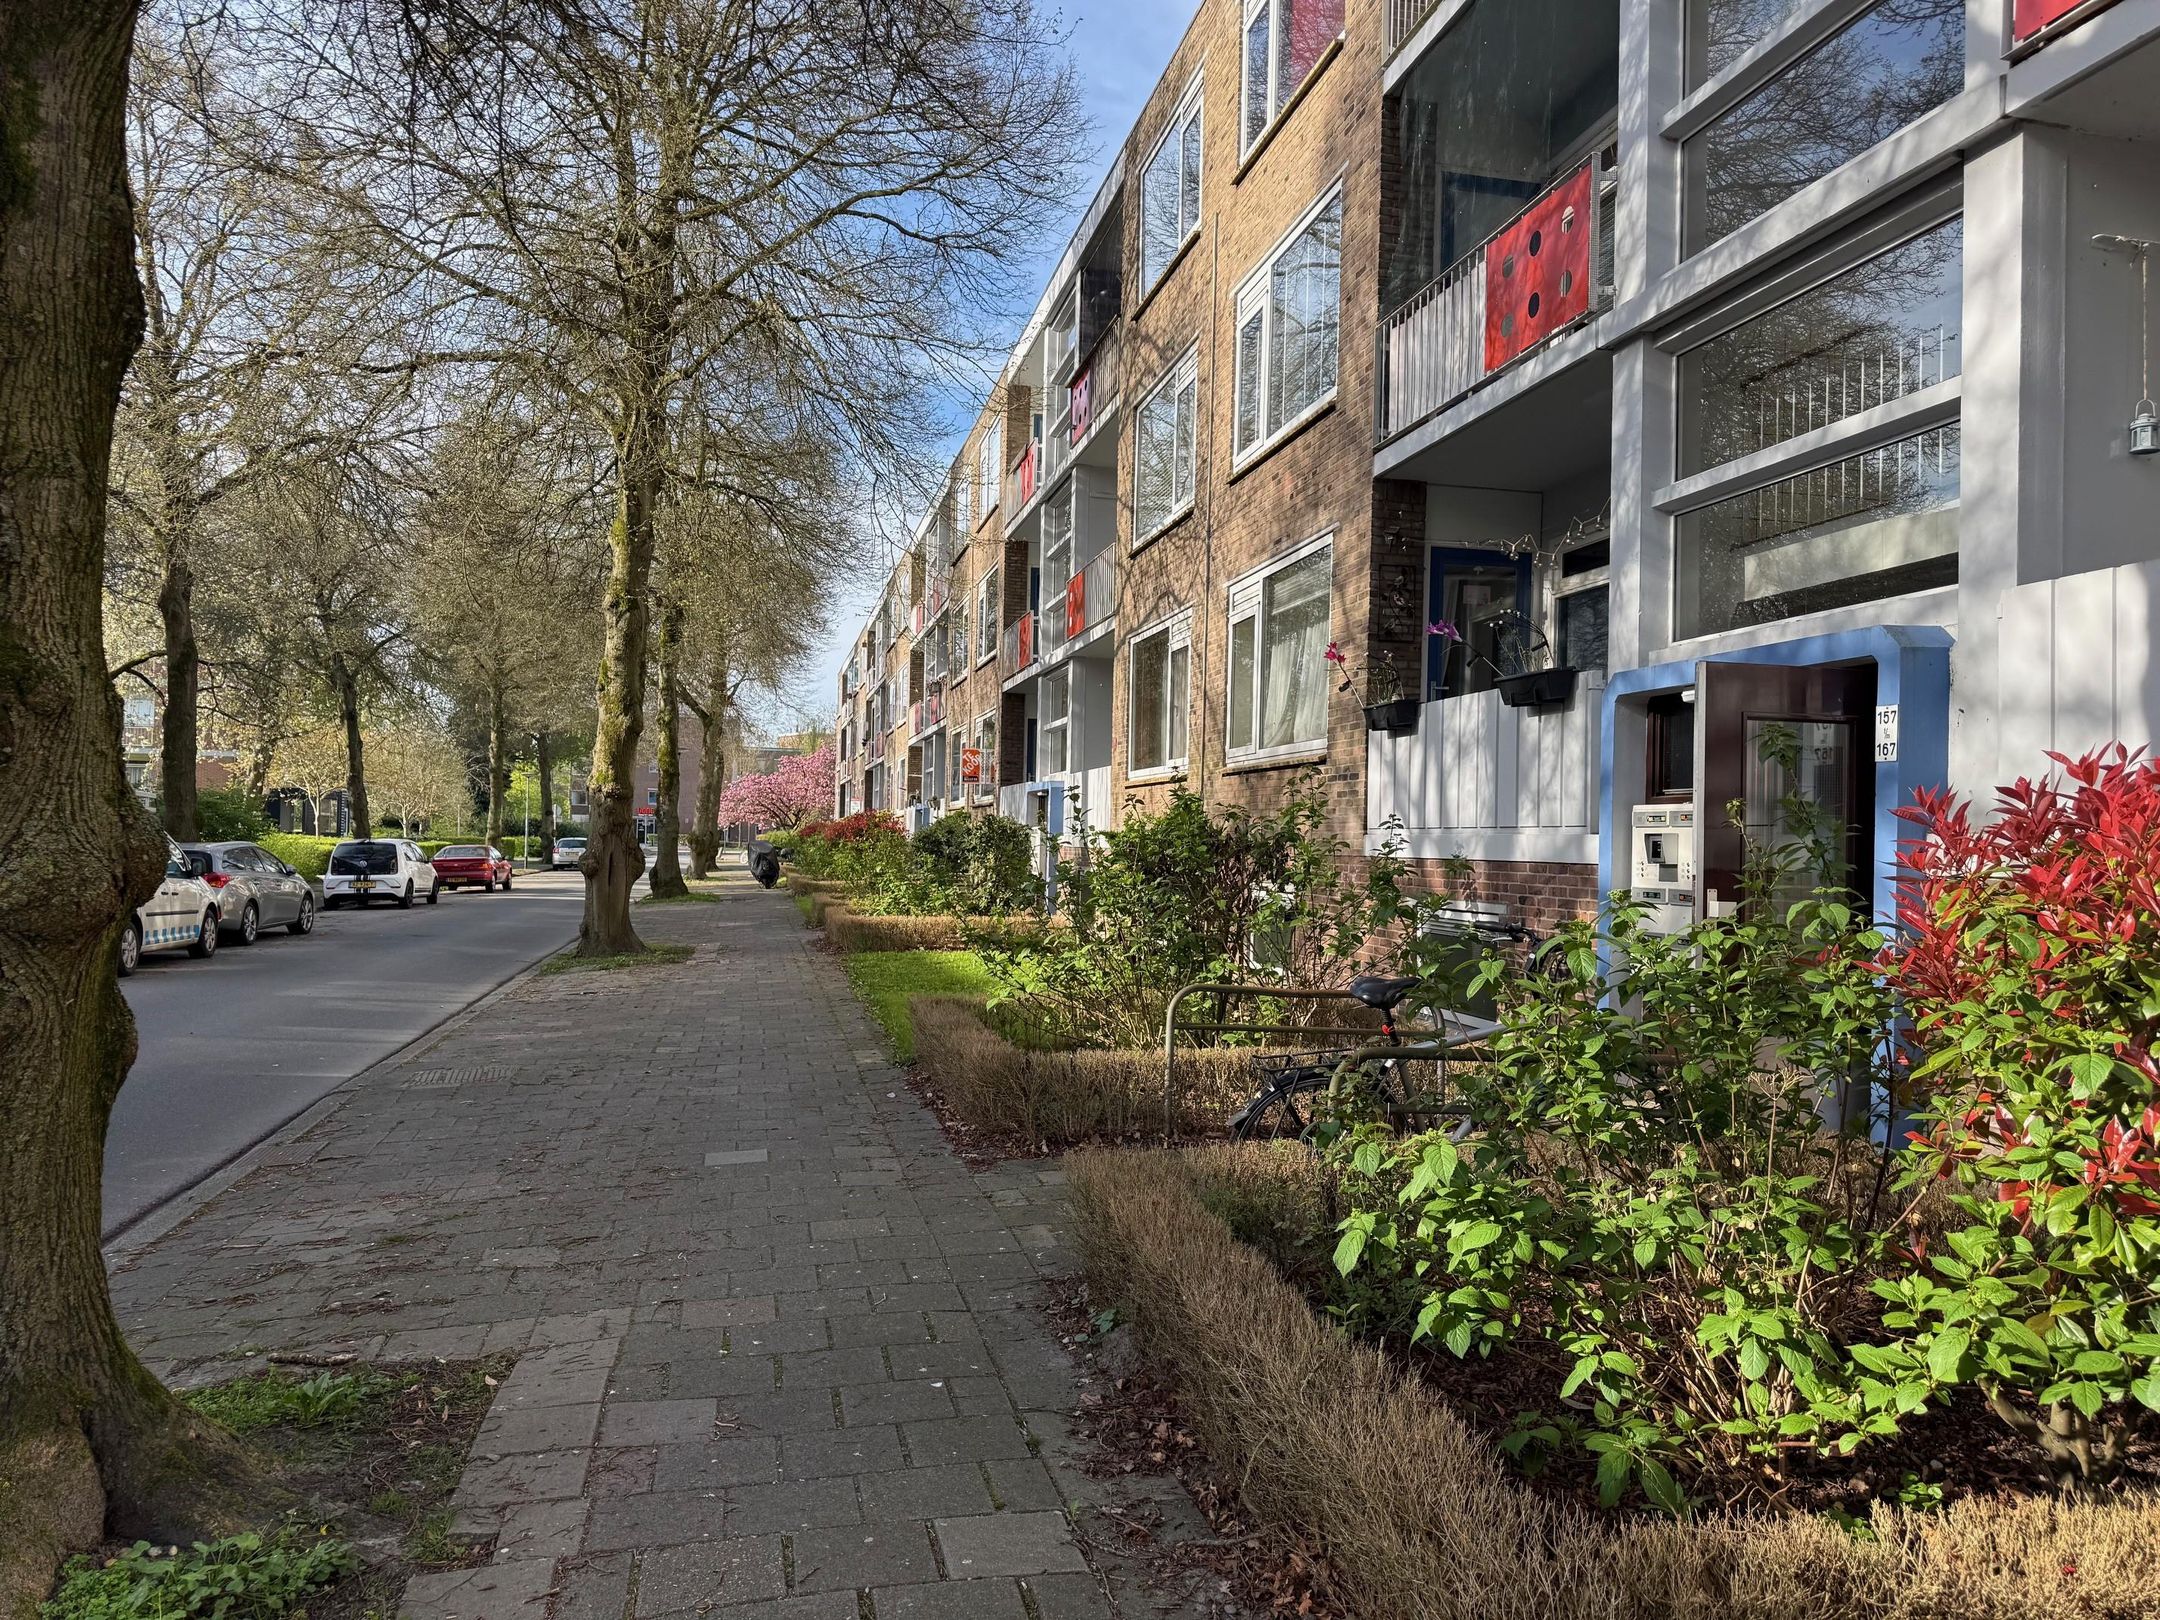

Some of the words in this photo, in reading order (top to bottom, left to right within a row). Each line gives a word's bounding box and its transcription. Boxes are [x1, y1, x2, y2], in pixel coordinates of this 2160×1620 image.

[1877, 710, 1897, 725] 157
[962, 751, 974, 762] TE
[1876, 742, 1896, 757] 167
